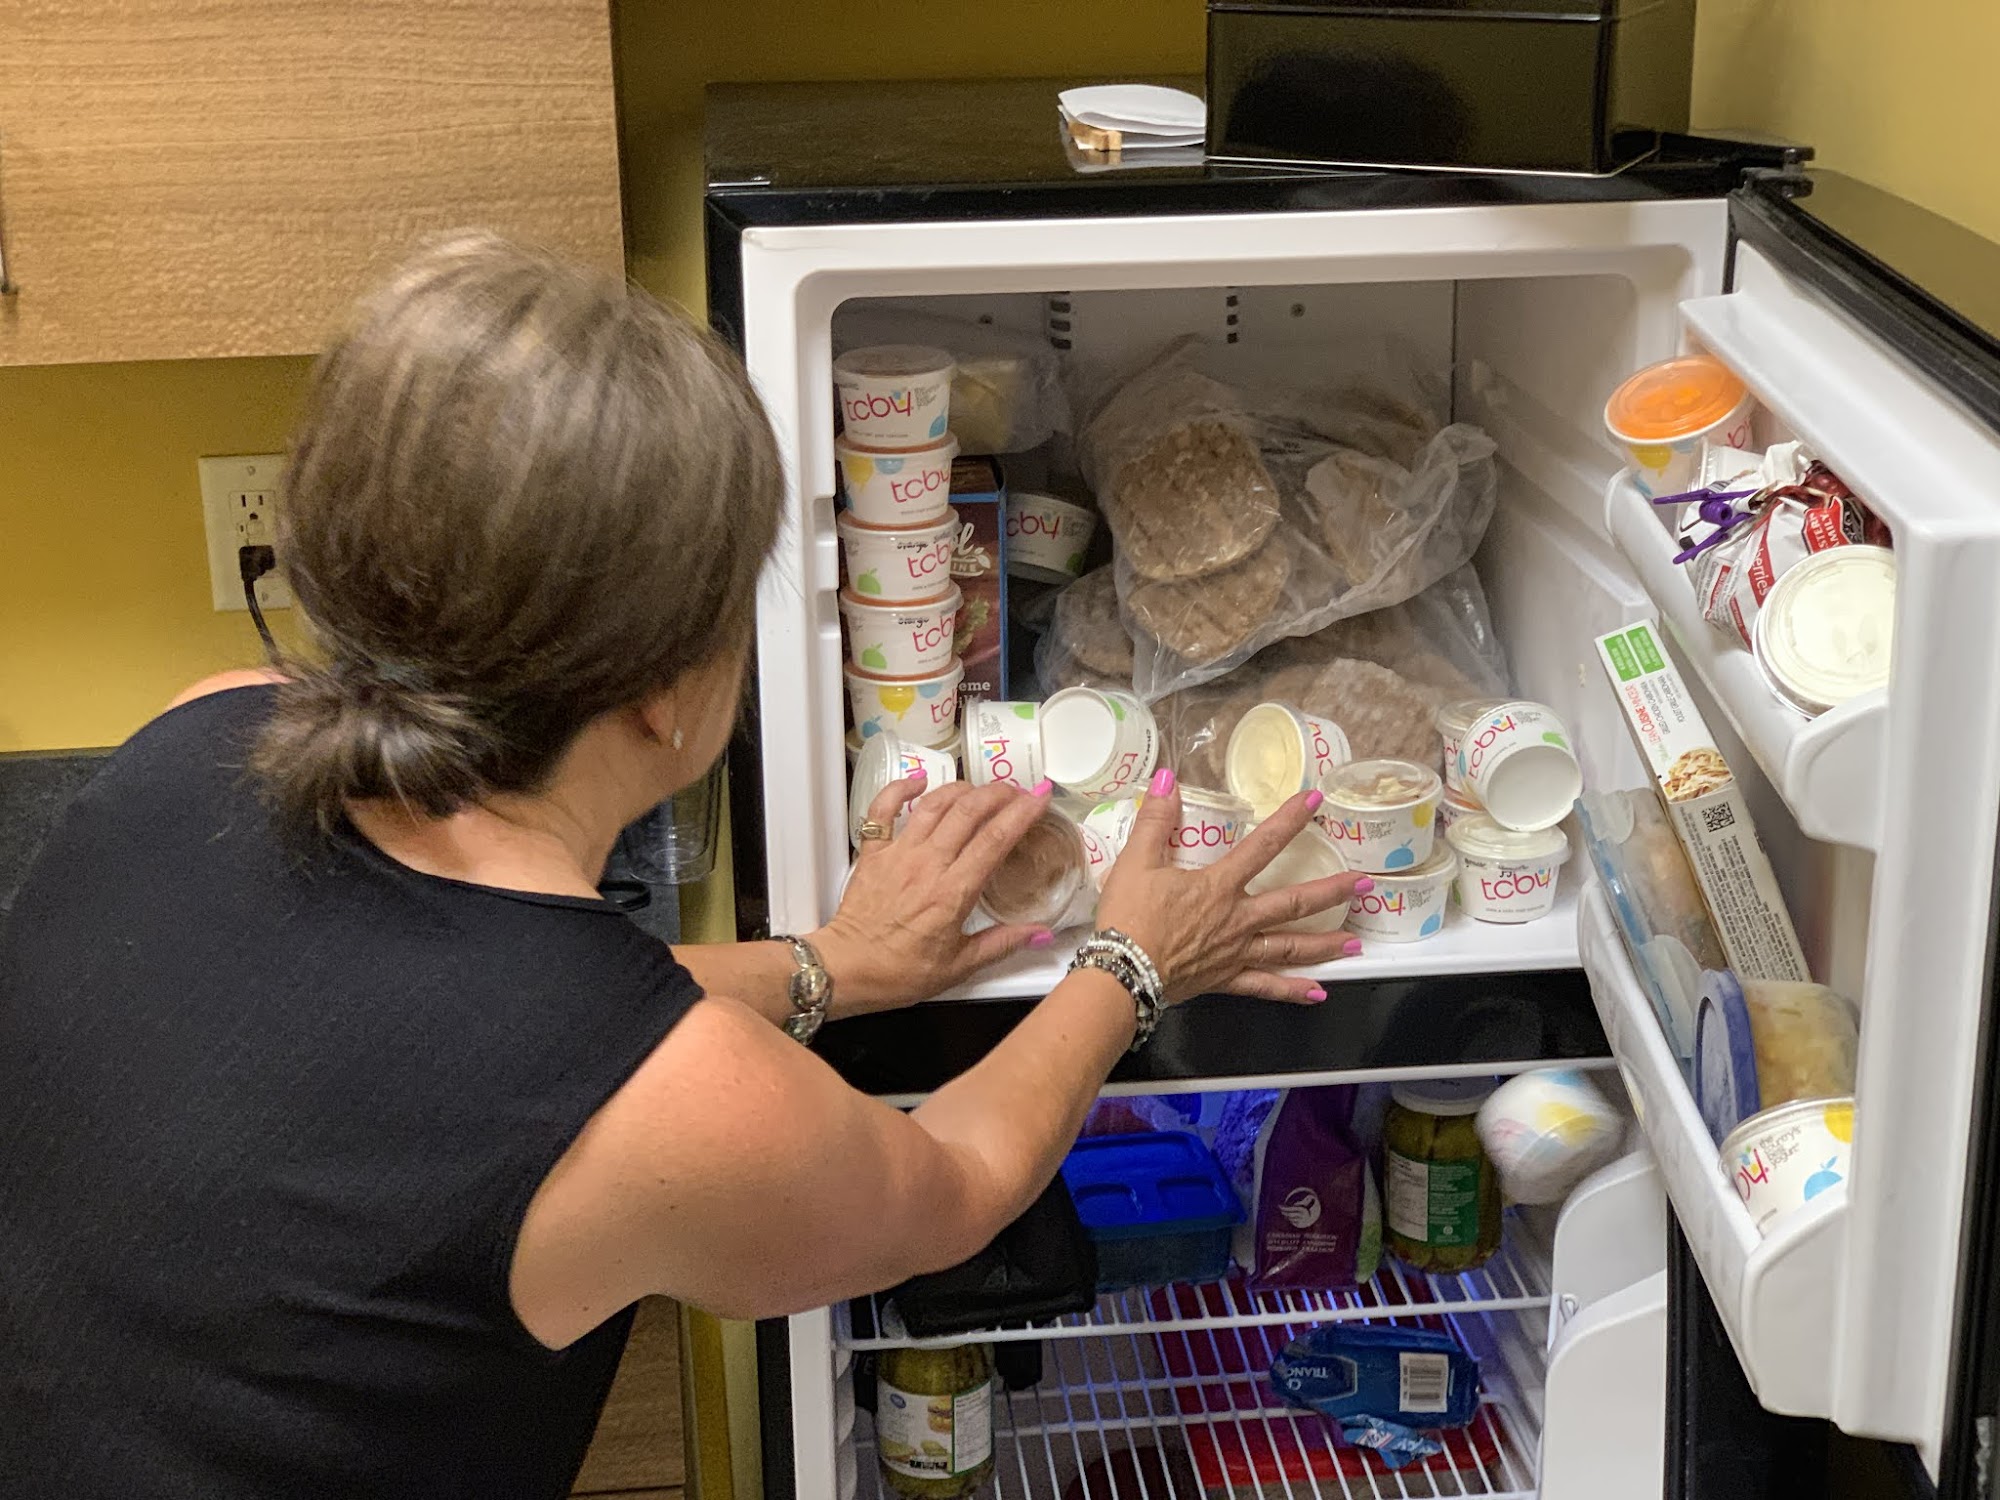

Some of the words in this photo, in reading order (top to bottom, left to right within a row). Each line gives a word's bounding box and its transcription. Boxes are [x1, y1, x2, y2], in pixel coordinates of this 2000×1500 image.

[845, 391, 911, 421] tcby
[1006, 511, 1060, 540] cby
[1820, 513, 1840, 551] AMILY
[907, 542, 950, 578] tcb
[913, 615, 954, 652] tcb
[958, 681, 991, 692] eme
[1635, 705, 1655, 732] CUISINE
[1468, 715, 1516, 780] tcby
[1082, 752, 1139, 798] tcby
[1481, 867, 1551, 900] tcby
